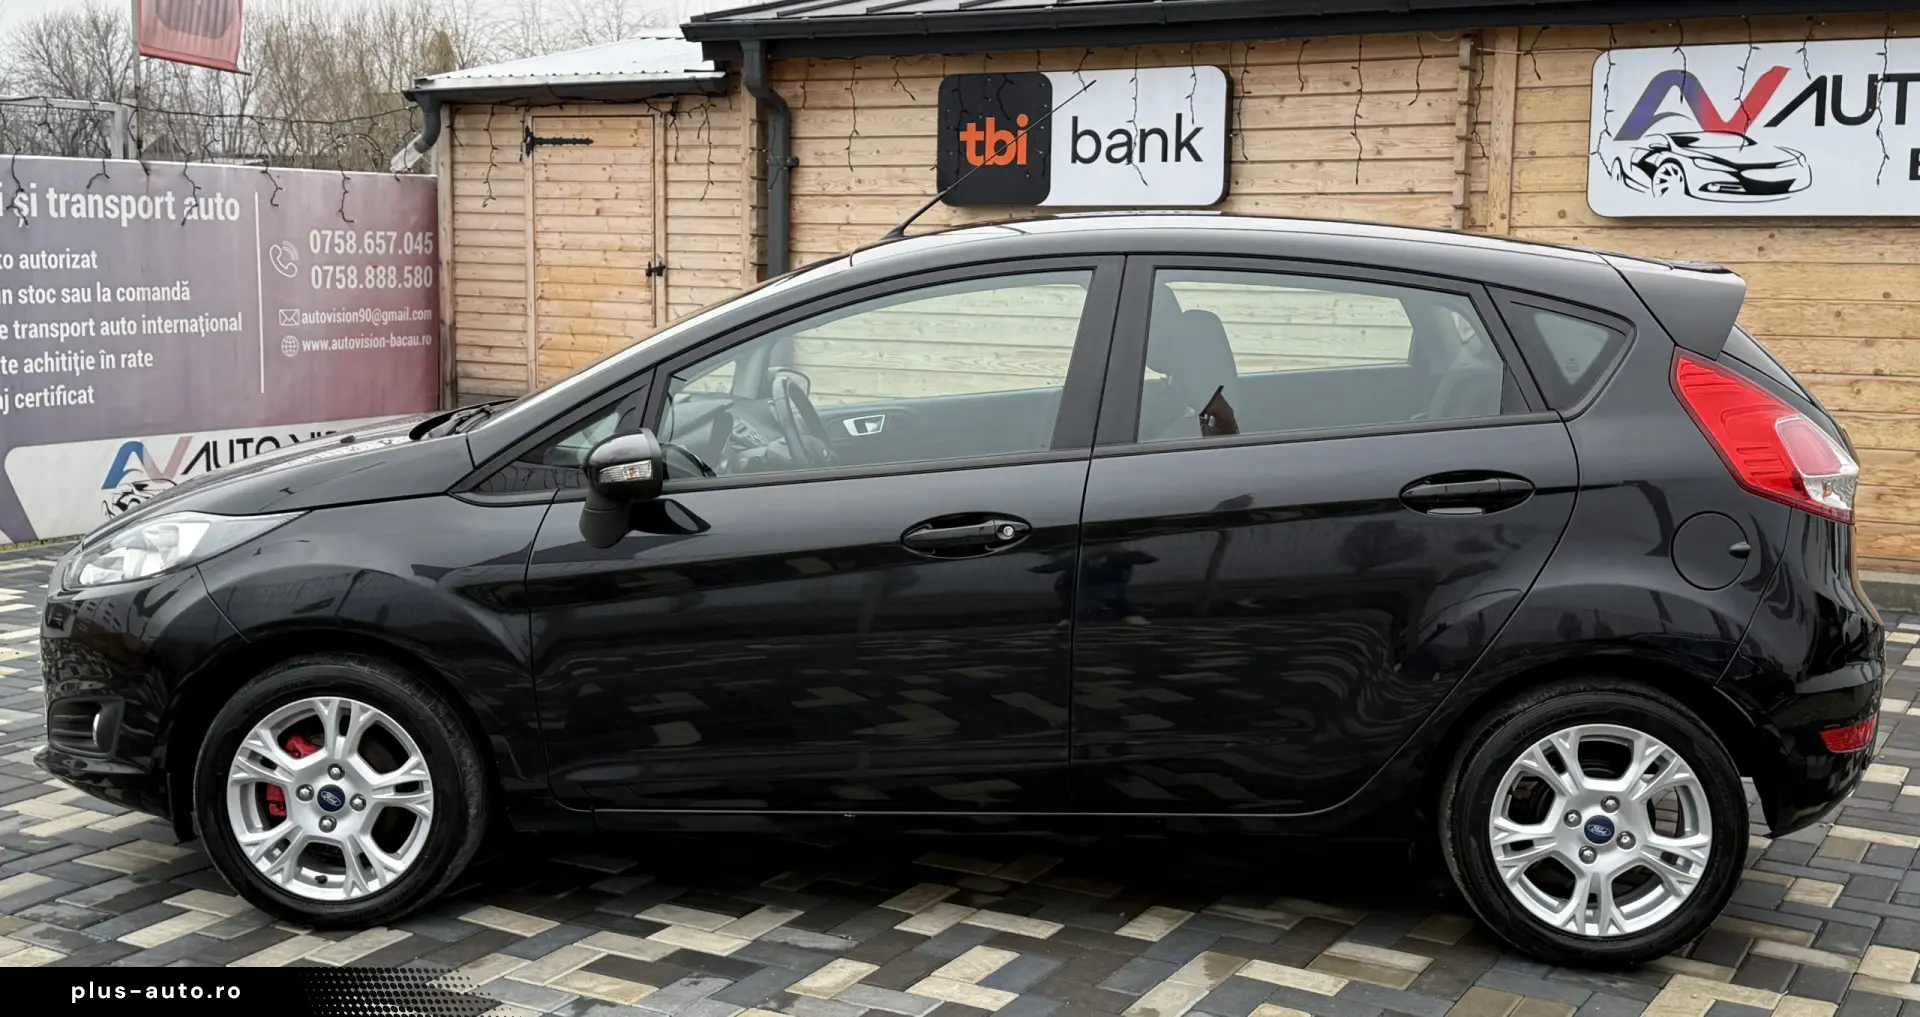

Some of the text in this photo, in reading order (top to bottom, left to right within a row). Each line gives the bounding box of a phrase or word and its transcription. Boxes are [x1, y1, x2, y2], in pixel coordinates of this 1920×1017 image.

[959, 113, 1204, 166] tbi bank
[14, 183, 37, 227] și
[46, 187, 176, 227] transport
[183, 192, 240, 221] auto
[309, 229, 434, 255] 0758.657.045
[19, 248, 98, 270] autorizat
[311, 265, 433, 289] 0758.888.580
[0, 280, 190, 305] n stoc sau la comandă
[302, 306, 432, 326] autovision90@gmail.com
[13, 318, 95, 342] transport
[100, 317, 137, 336] auto
[302, 333, 432, 352] www.autovision-bacau.ro
[0, 355, 18, 375] te
[99, 349, 116, 369] în
[120, 349, 153, 368] rate
[14, 384, 95, 409] certificat
